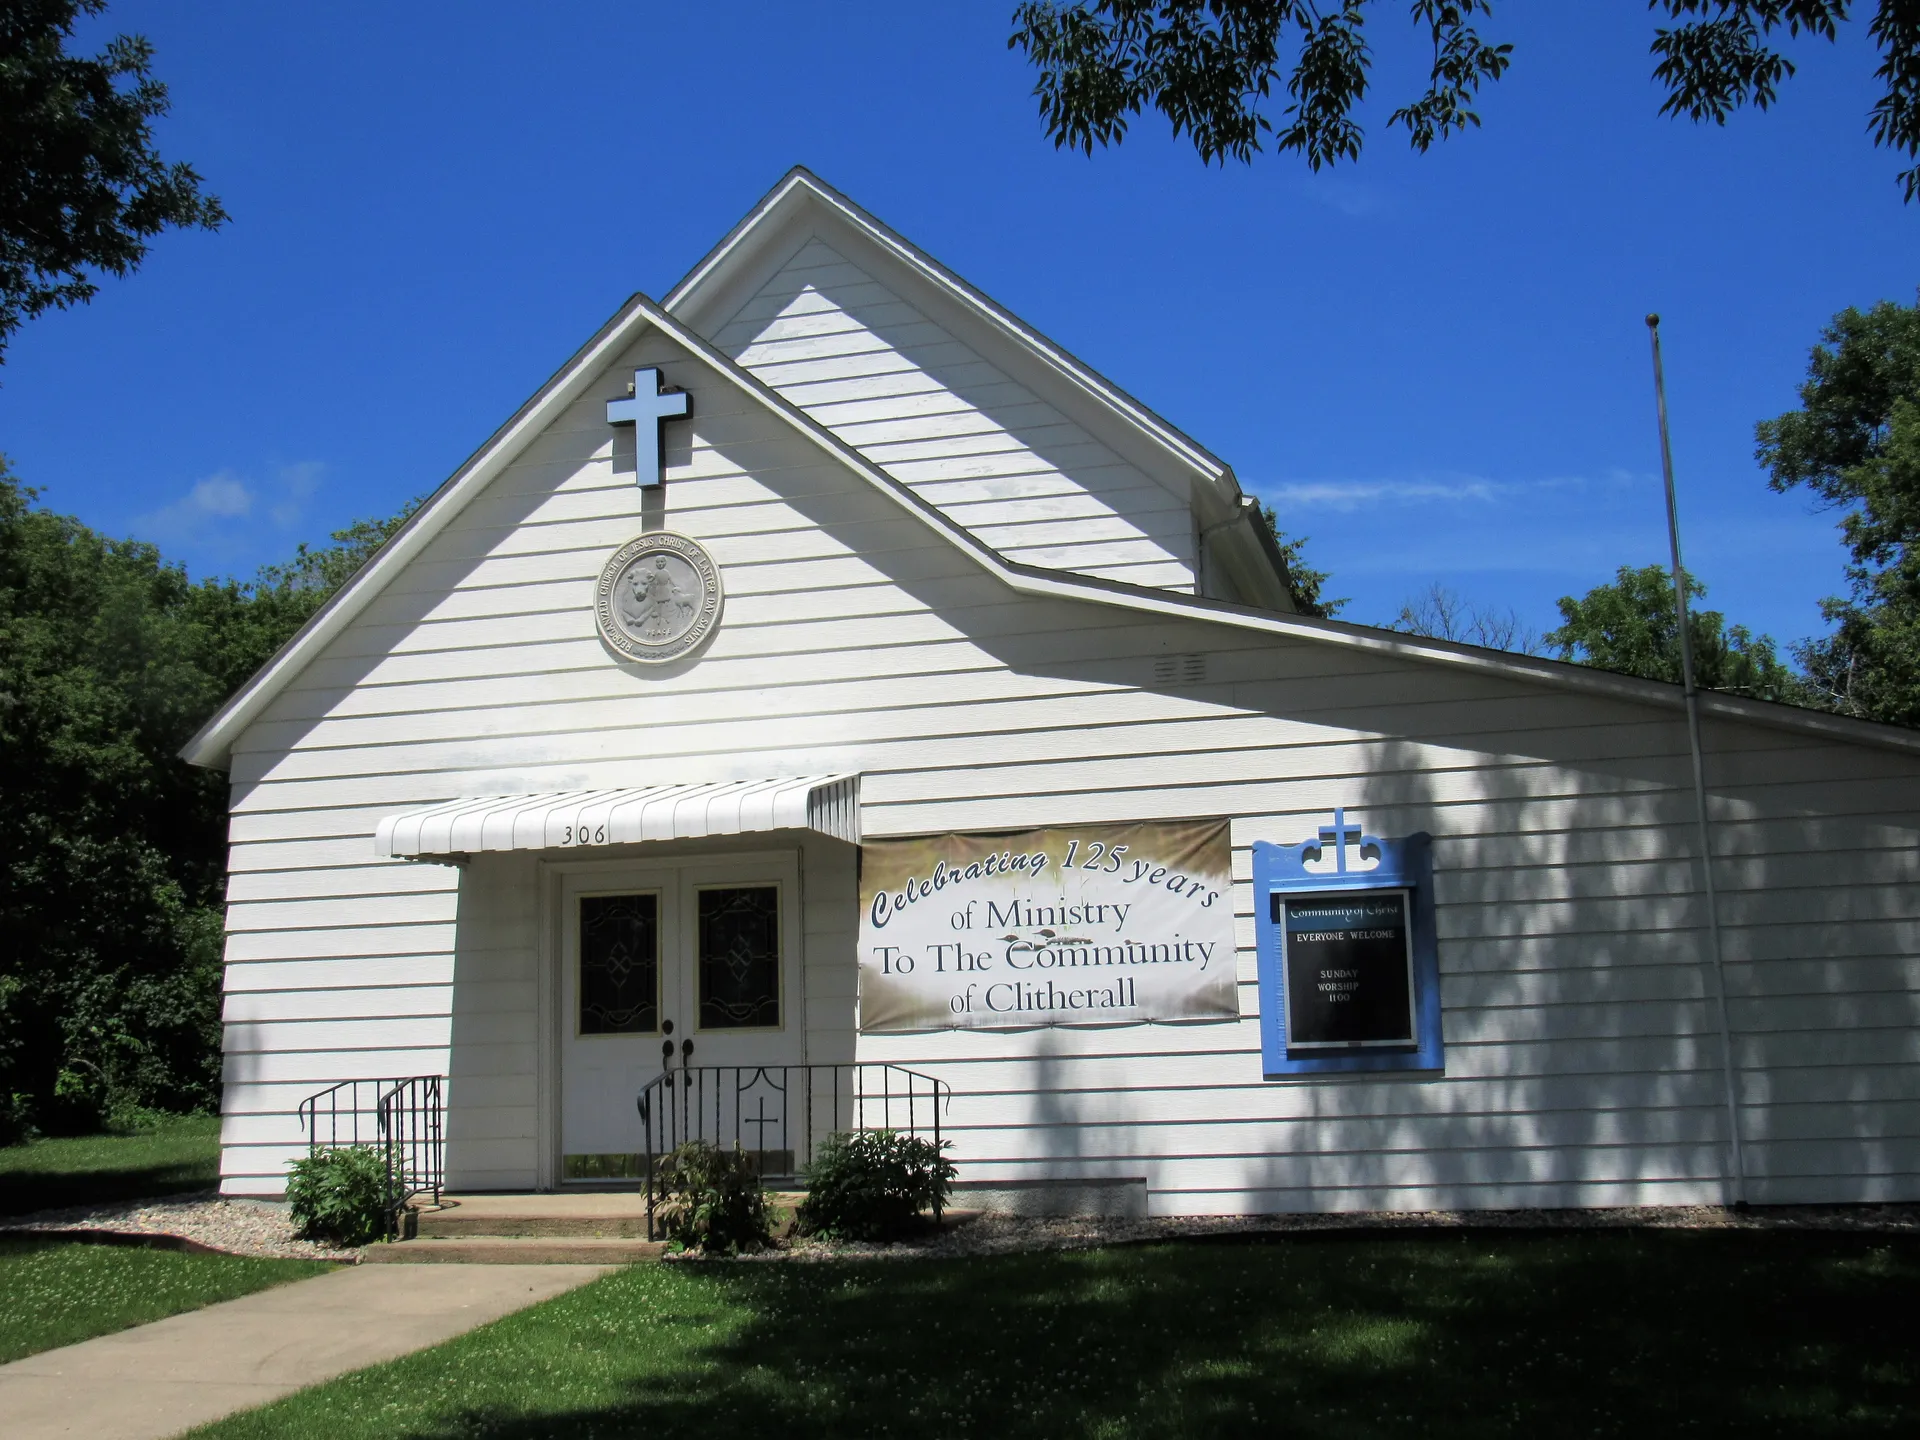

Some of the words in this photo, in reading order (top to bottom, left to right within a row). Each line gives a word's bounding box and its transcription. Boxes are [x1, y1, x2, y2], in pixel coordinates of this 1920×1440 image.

[631, 537, 654, 555] JESUS
[658, 535, 689, 551] CHRIST
[688, 547, 701, 559] OF
[618, 550, 629, 562] OF
[600, 561, 619, 597] CHURCH
[697, 557, 716, 595] LATTER
[704, 598, 716, 617] DAY
[599, 600, 633, 652] REORGANIZED
[645, 628, 672, 637] PEACE
[684, 618, 709, 646] SAINTS
[562, 824, 604, 844] 306
[871, 850, 1049, 929] Celebrating
[1061, 840, 1129, 873] 125
[1122, 858, 1219, 908] years
[950, 901, 976, 930] of
[985, 896, 1132, 933] Ministry
[1290, 905, 1353, 922] Community
[1353, 905, 1364, 919] of
[1366, 902, 1398, 915] Christ
[1296, 932, 1344, 942] EVERYONE
[1350, 929, 1395, 939] WELCOME
[872, 946, 915, 975] To
[925, 943, 992, 973] The
[1005, 934, 1216, 971] Community
[1320, 969, 1358, 979] SUNDAY
[949, 983, 976, 1014] of
[984, 977, 1137, 1013] Clitherall
[1317, 982, 1359, 991] WORSHIP
